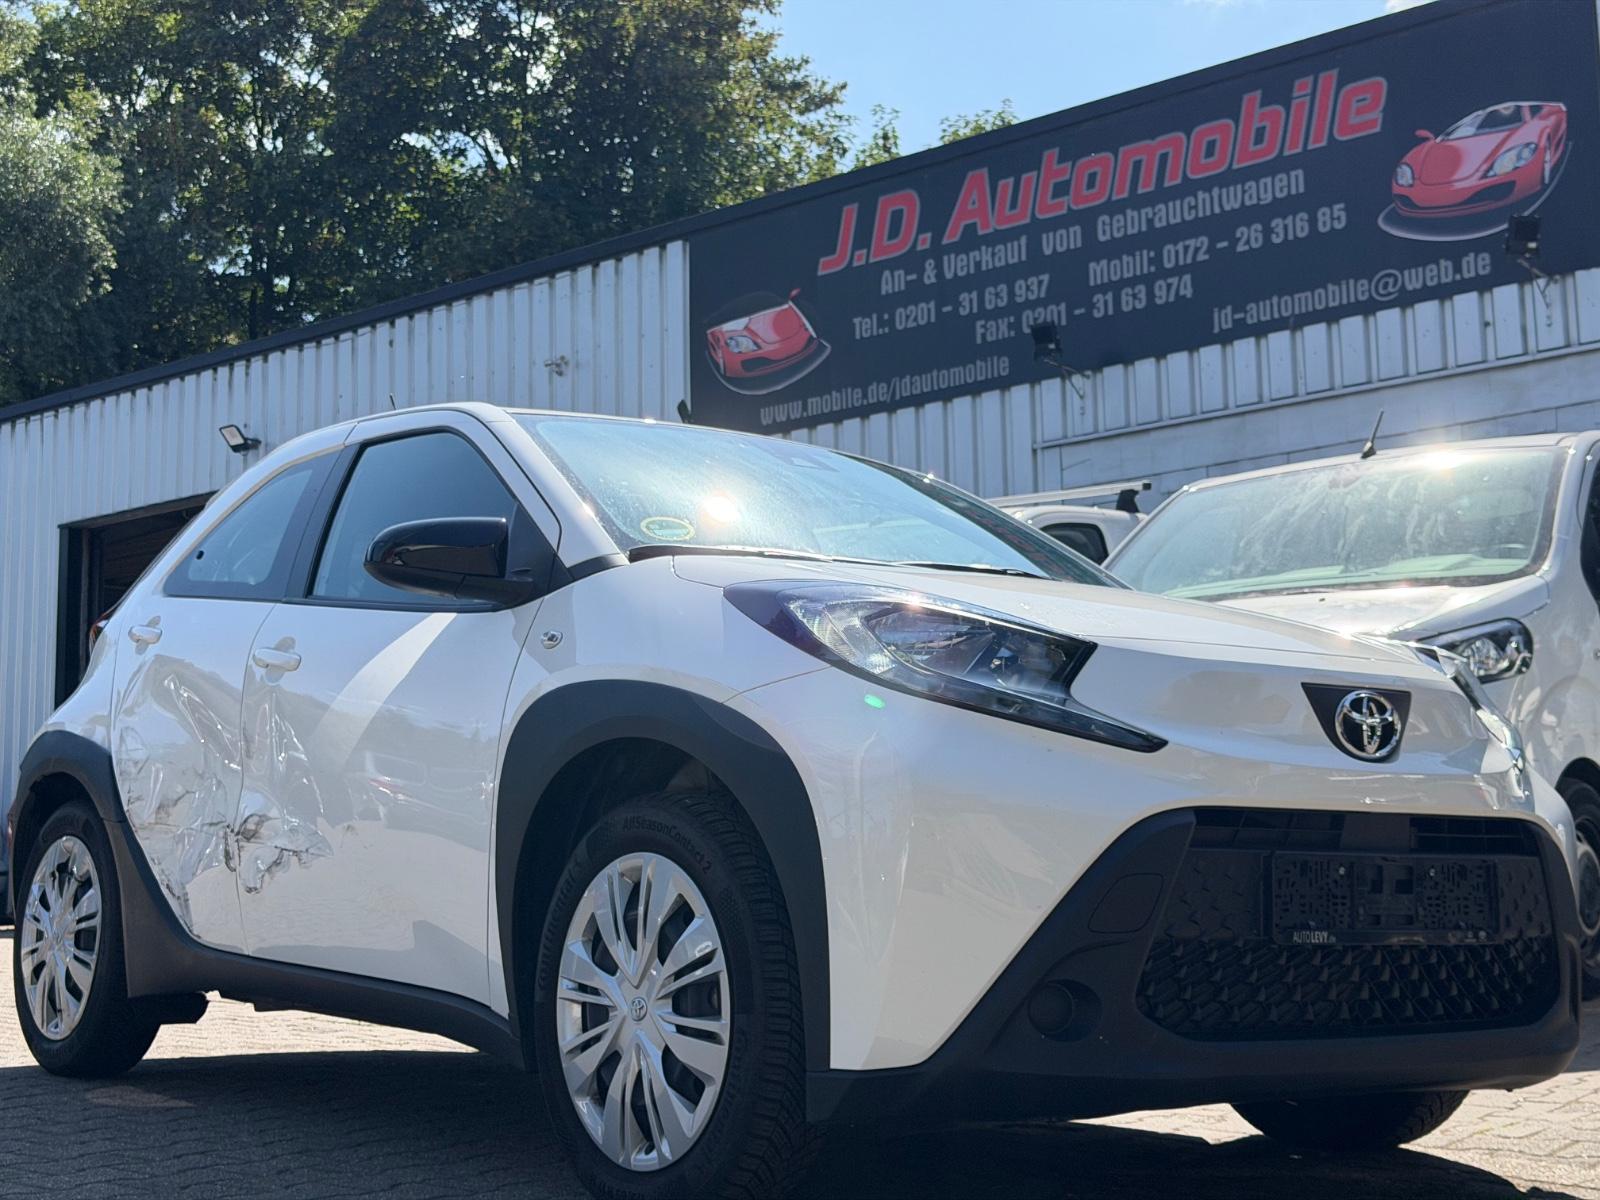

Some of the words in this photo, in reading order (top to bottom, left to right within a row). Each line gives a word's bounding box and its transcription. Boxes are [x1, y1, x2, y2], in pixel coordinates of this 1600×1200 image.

[817, 188, 932, 276] J.D.
[942, 68, 1388, 245] Automobile
[880, 269, 917, 295] An-
[923, 258, 937, 285] &
[942, 235, 1027, 279] Verkauf
[1042, 224, 1082, 256] von
[1097, 168, 1305, 242] Gebrauchtwagen
[1088, 249, 1156, 287] Mobil:
[1162, 235, 1210, 269] 0172
[1235, 223, 1263, 252] 26
[1270, 212, 1309, 244] 316
[1317, 203, 1347, 233] 85
[853, 313, 889, 339] Tel.:
[895, 300, 936, 331] 0201
[958, 290, 978, 316] 31
[984, 284, 1007, 310] 63
[1014, 273, 1050, 303] 937
[976, 316, 1015, 344] Fax:
[1092, 291, 1113, 318] 31
[1120, 284, 1146, 313] 63
[1154, 274, 1193, 304] 974
[1213, 252, 1491, 333] jd-automobile@web.de
[760, 356, 1010, 426] www.mobile.de/jdautomobile
